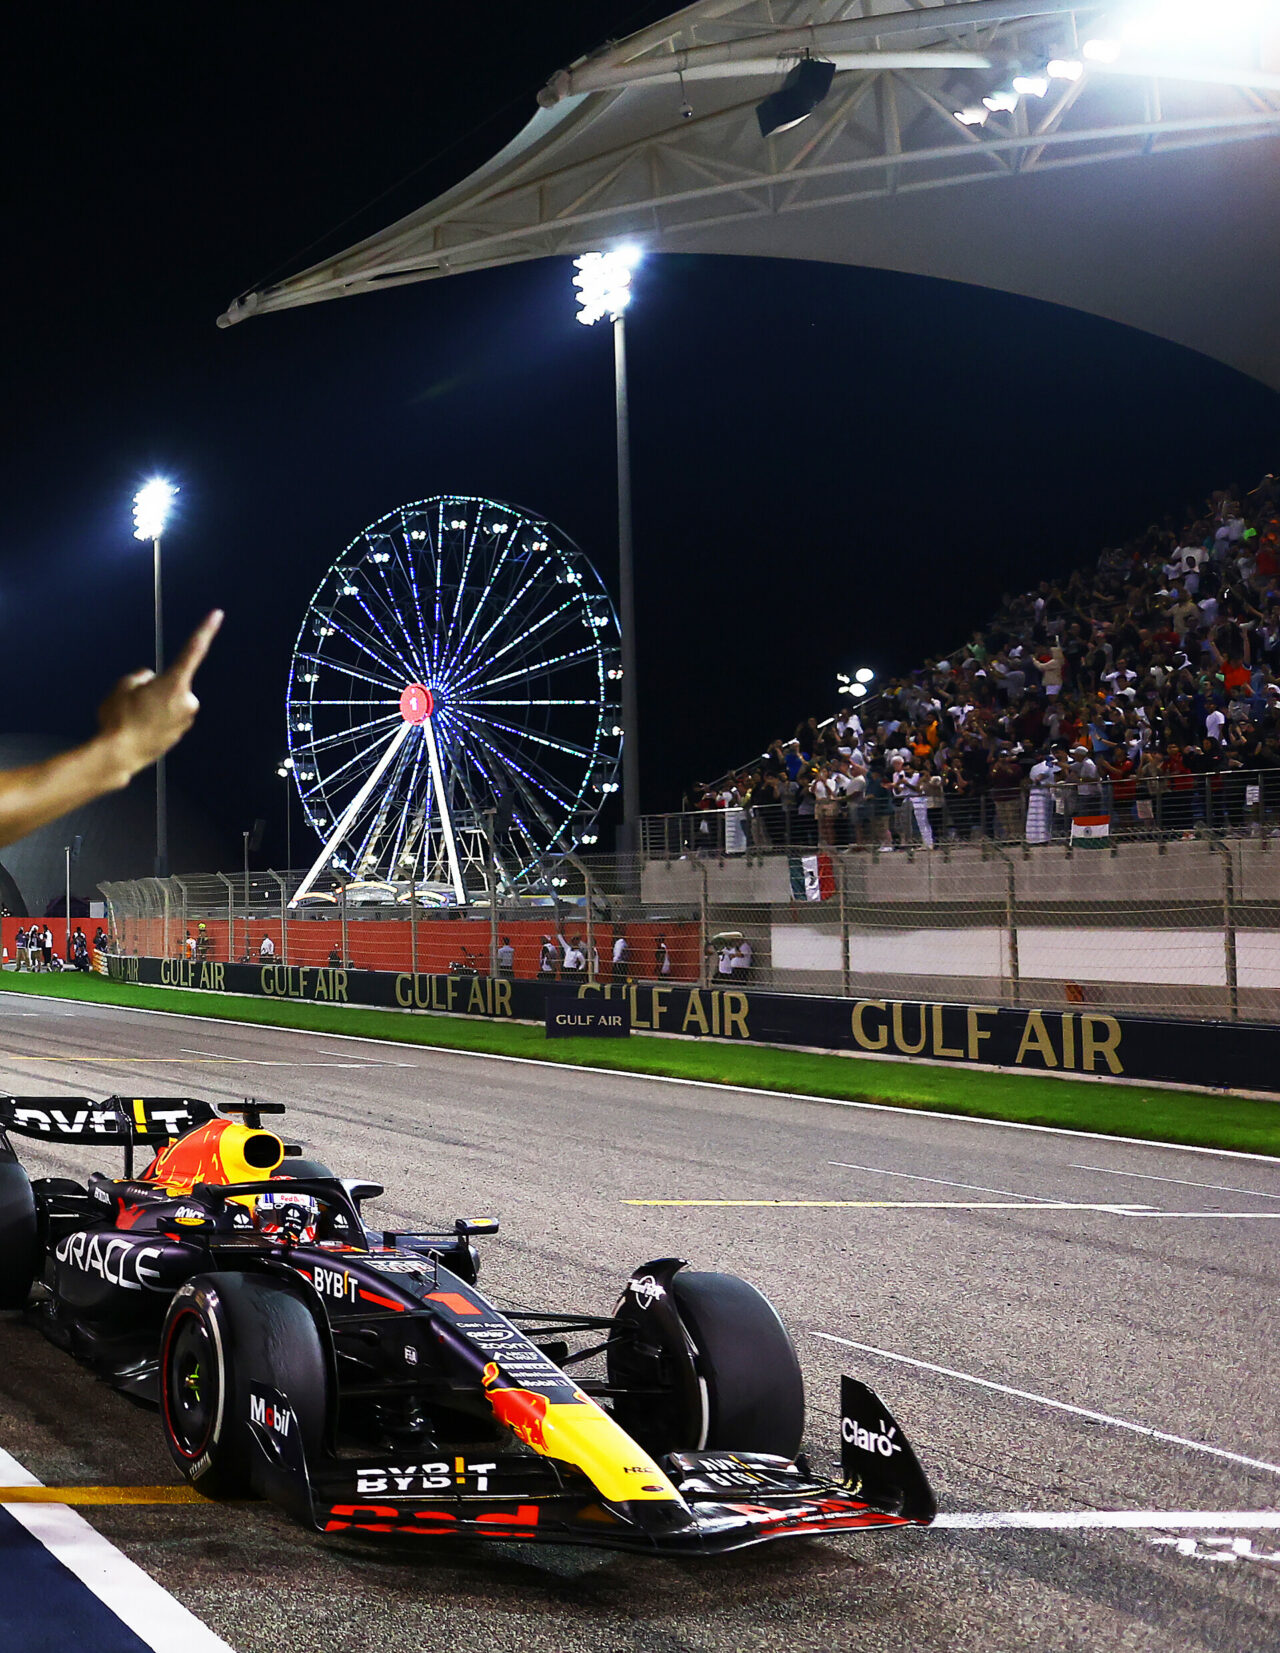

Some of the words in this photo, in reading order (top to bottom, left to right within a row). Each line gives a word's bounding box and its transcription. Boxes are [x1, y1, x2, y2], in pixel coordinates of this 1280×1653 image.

[160, 959, 197, 987] GULF
[199, 961, 225, 991] AIR
[260, 965, 310, 997] GULF
[314, 968, 349, 1002] AIR
[395, 974, 461, 1011] GULF
[467, 975, 513, 1016] AIR
[682, 987, 751, 1039] AIR
[555, 1013, 595, 1027] GULF
[597, 1014, 623, 1028] AIR
[851, 1000, 999, 1060] GULF
[1015, 1009, 1124, 1075] AIR
[314, 1266, 359, 1304] BYBIT
[250, 1394, 290, 1437] Mobil
[356, 1456, 497, 1493] BYBIT
